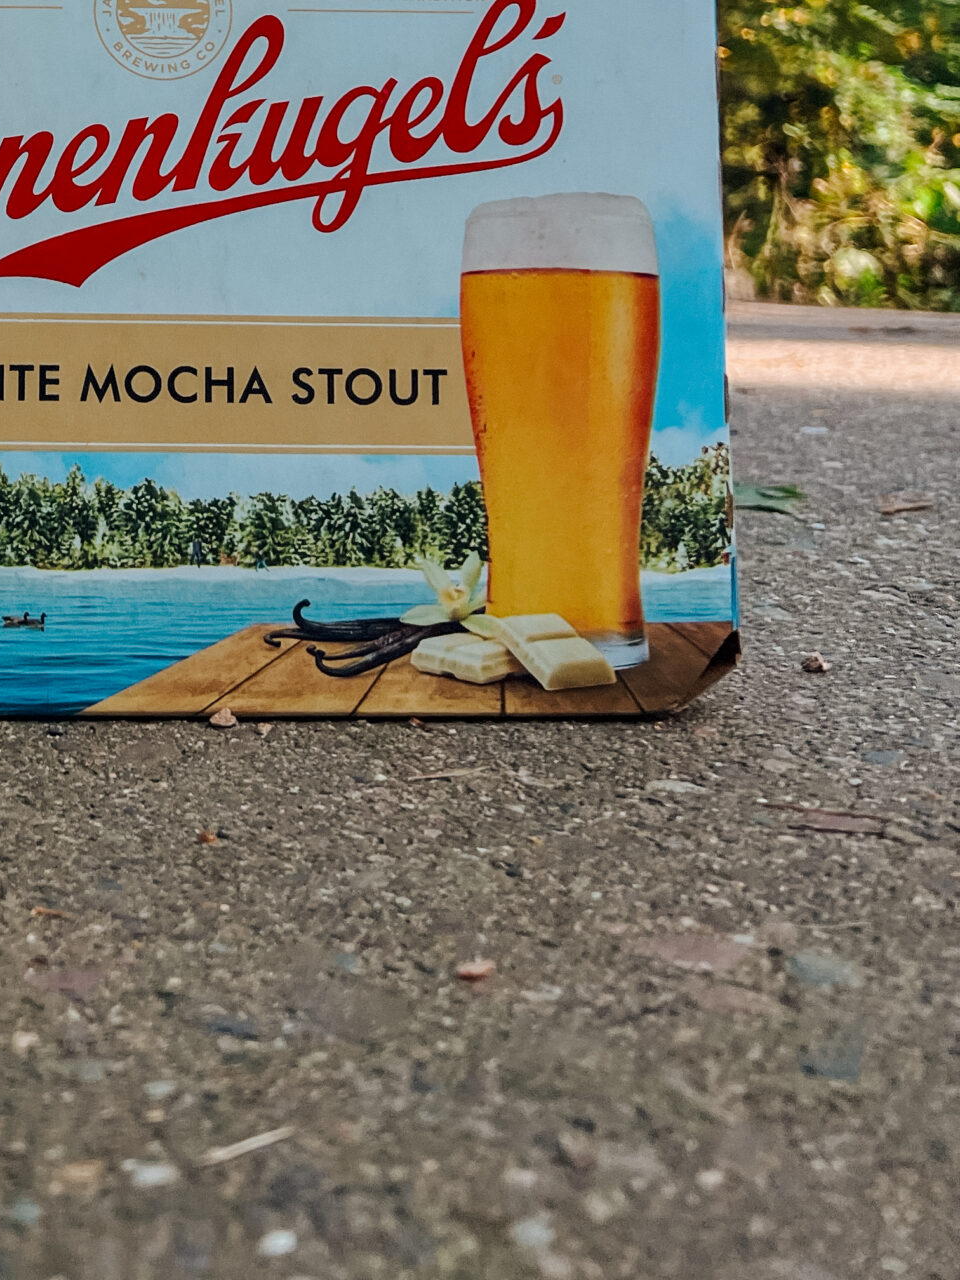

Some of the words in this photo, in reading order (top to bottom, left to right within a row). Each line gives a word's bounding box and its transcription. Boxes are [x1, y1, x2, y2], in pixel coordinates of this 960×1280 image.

[112, 40, 192, 73] BREWING
[195, 41, 216, 61] CO
[79, 362, 273, 405] MOCHA
[290, 366, 448, 407] STOUT
